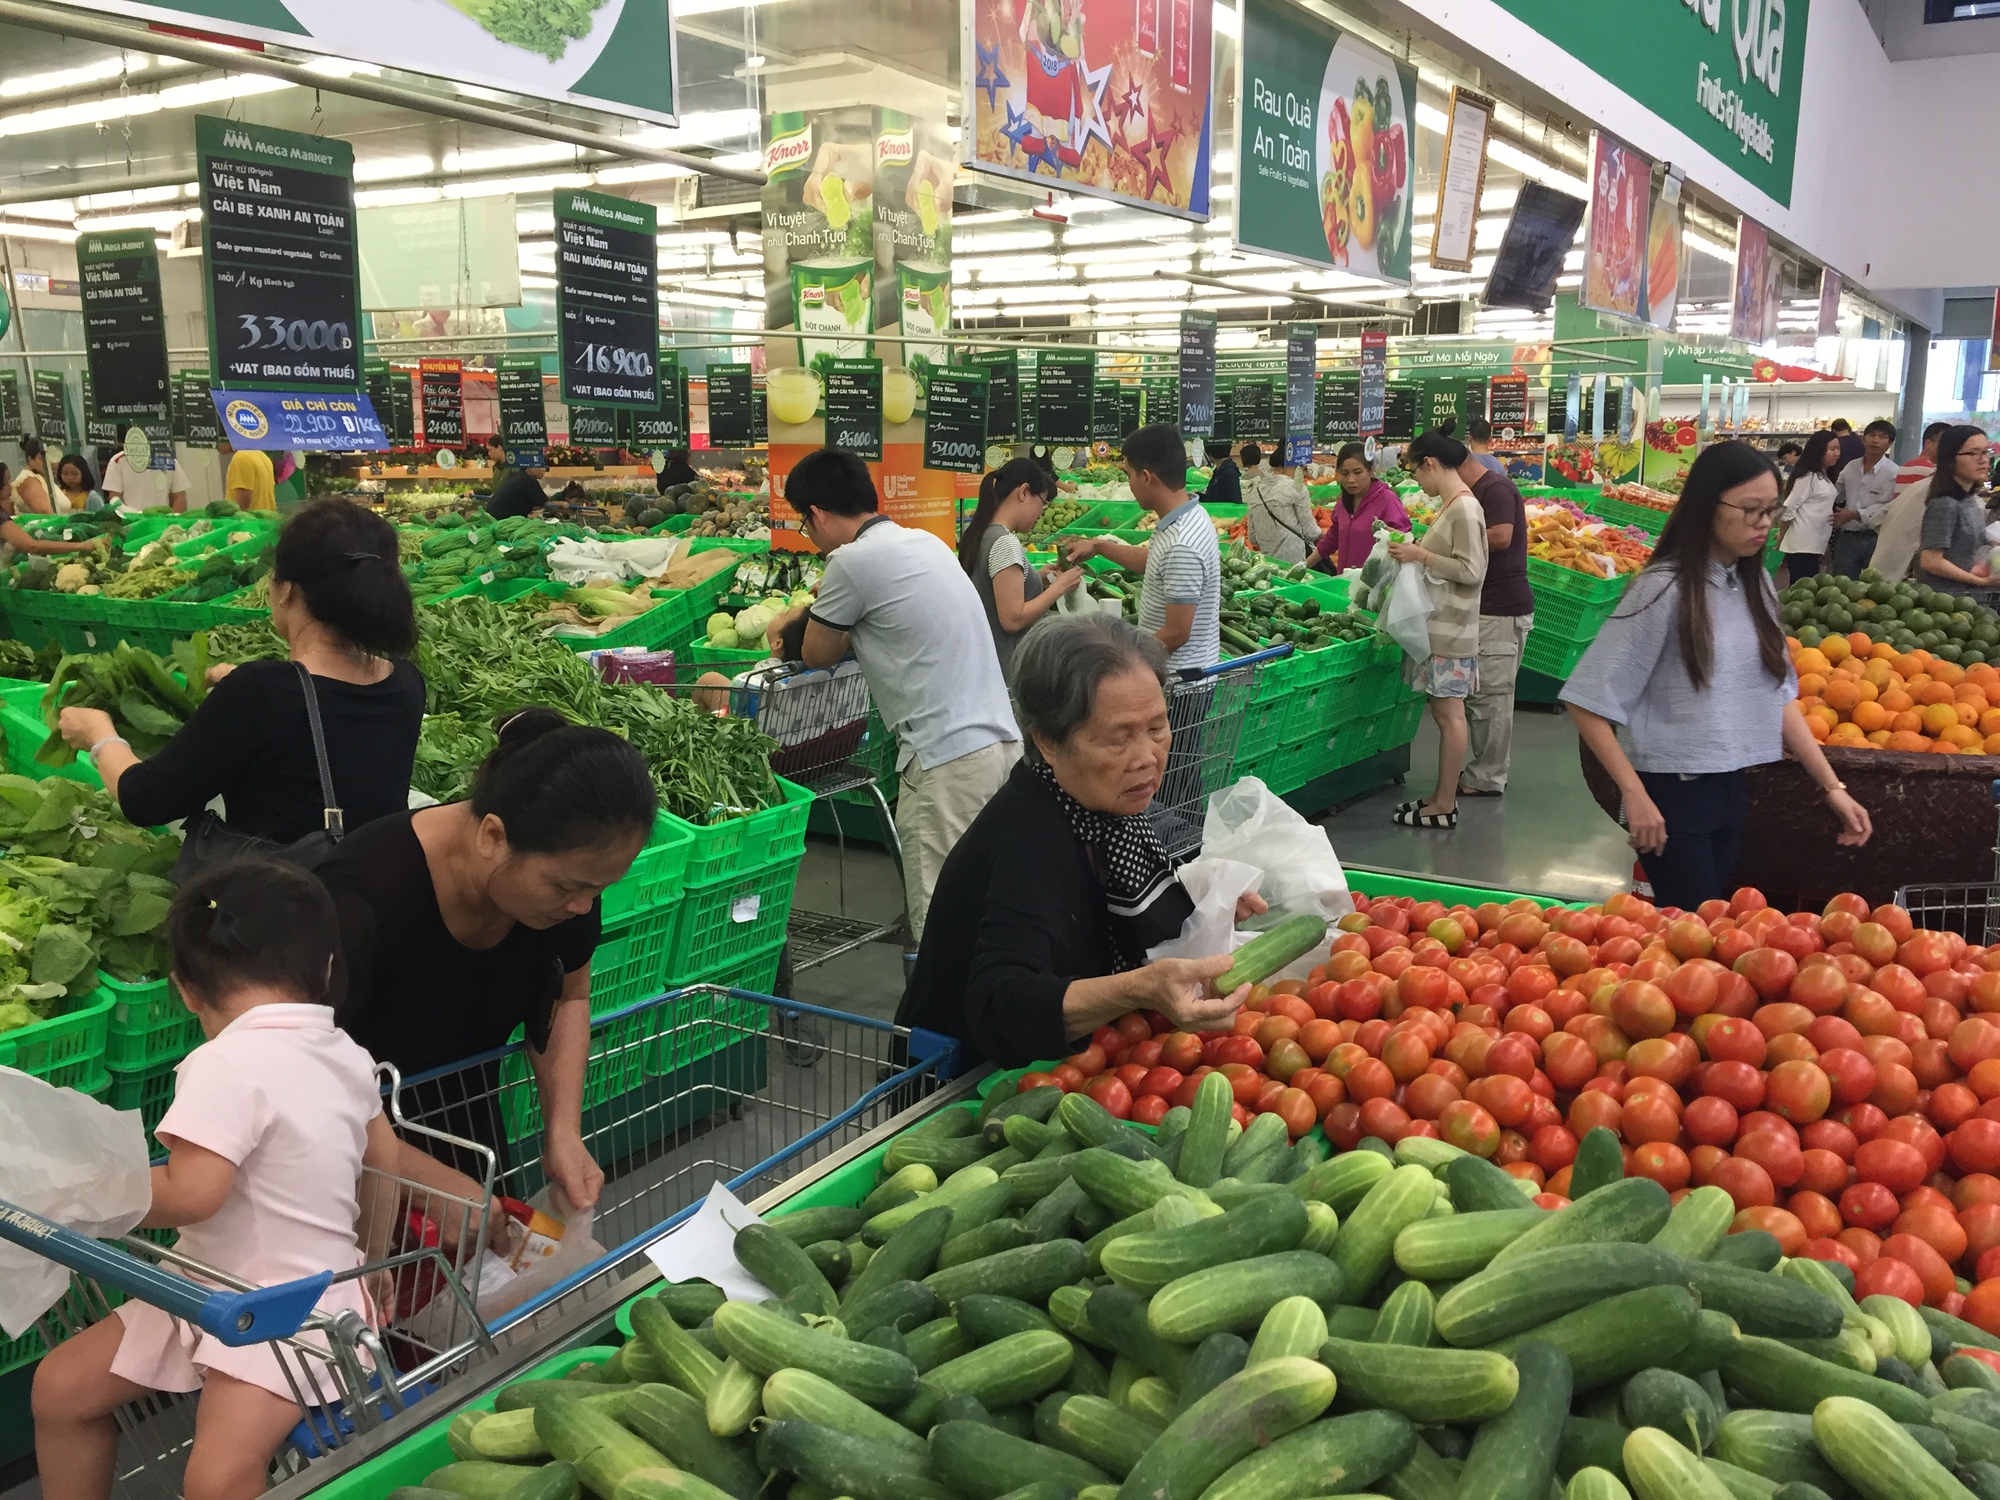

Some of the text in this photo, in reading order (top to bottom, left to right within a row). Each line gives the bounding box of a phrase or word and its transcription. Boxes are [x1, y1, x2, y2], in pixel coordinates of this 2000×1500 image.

[1043, 55, 1059, 72] 2018
[1254, 77, 1311, 130] Rau Quả
[1696, 61, 1727, 123] Fruits
[1733, 94, 1775, 165] Vegetables
[767, 139, 810, 168] Knorr
[877, 140, 912, 158] Knorr
[1253, 125, 1310, 172] An Toàn
[212, 172, 282, 196] Việt Nam
[1258, 164, 1269, 177] Safe
[1269, 167, 1282, 181] Fruits
[1287, 173, 1310, 189] Vegetables
[213, 197, 345, 228] CẢI BẸ XANH AN TOÀN
[767, 211, 807, 229] Vị tuyệt
[878, 205, 908, 226] Vị tuyệt
[563, 230, 609, 250] Việt Nam
[767, 228, 847, 247] như Chanh Tươi
[892, 230, 918, 247] Chanh
[216, 241, 233, 251] Safe
[233, 244, 253, 253] green
[254, 246, 283, 255] mustard
[563, 251, 648, 275] RAU MUỐNG AN TOÀN
[85, 271, 120, 284] Việt Nam
[249, 275, 263, 288] Kg
[114, 288, 124, 297] AN
[803, 290, 824, 300] Knorr
[818, 324, 841, 332] CHANH
[1474, 351, 1500, 364] Ngày
[229, 361, 355, 380] +VAT (BAO GỒM THUẾ)
[572, 385, 592, 395] +VAT
[594, 386, 613, 397] (BAO
[633, 387, 655, 401] THUẾ)
[944, 386, 959, 394] Nam
[1434, 393, 1457, 403] RAU
[281, 399, 357, 413] GIÁ CHỈ CÒN
